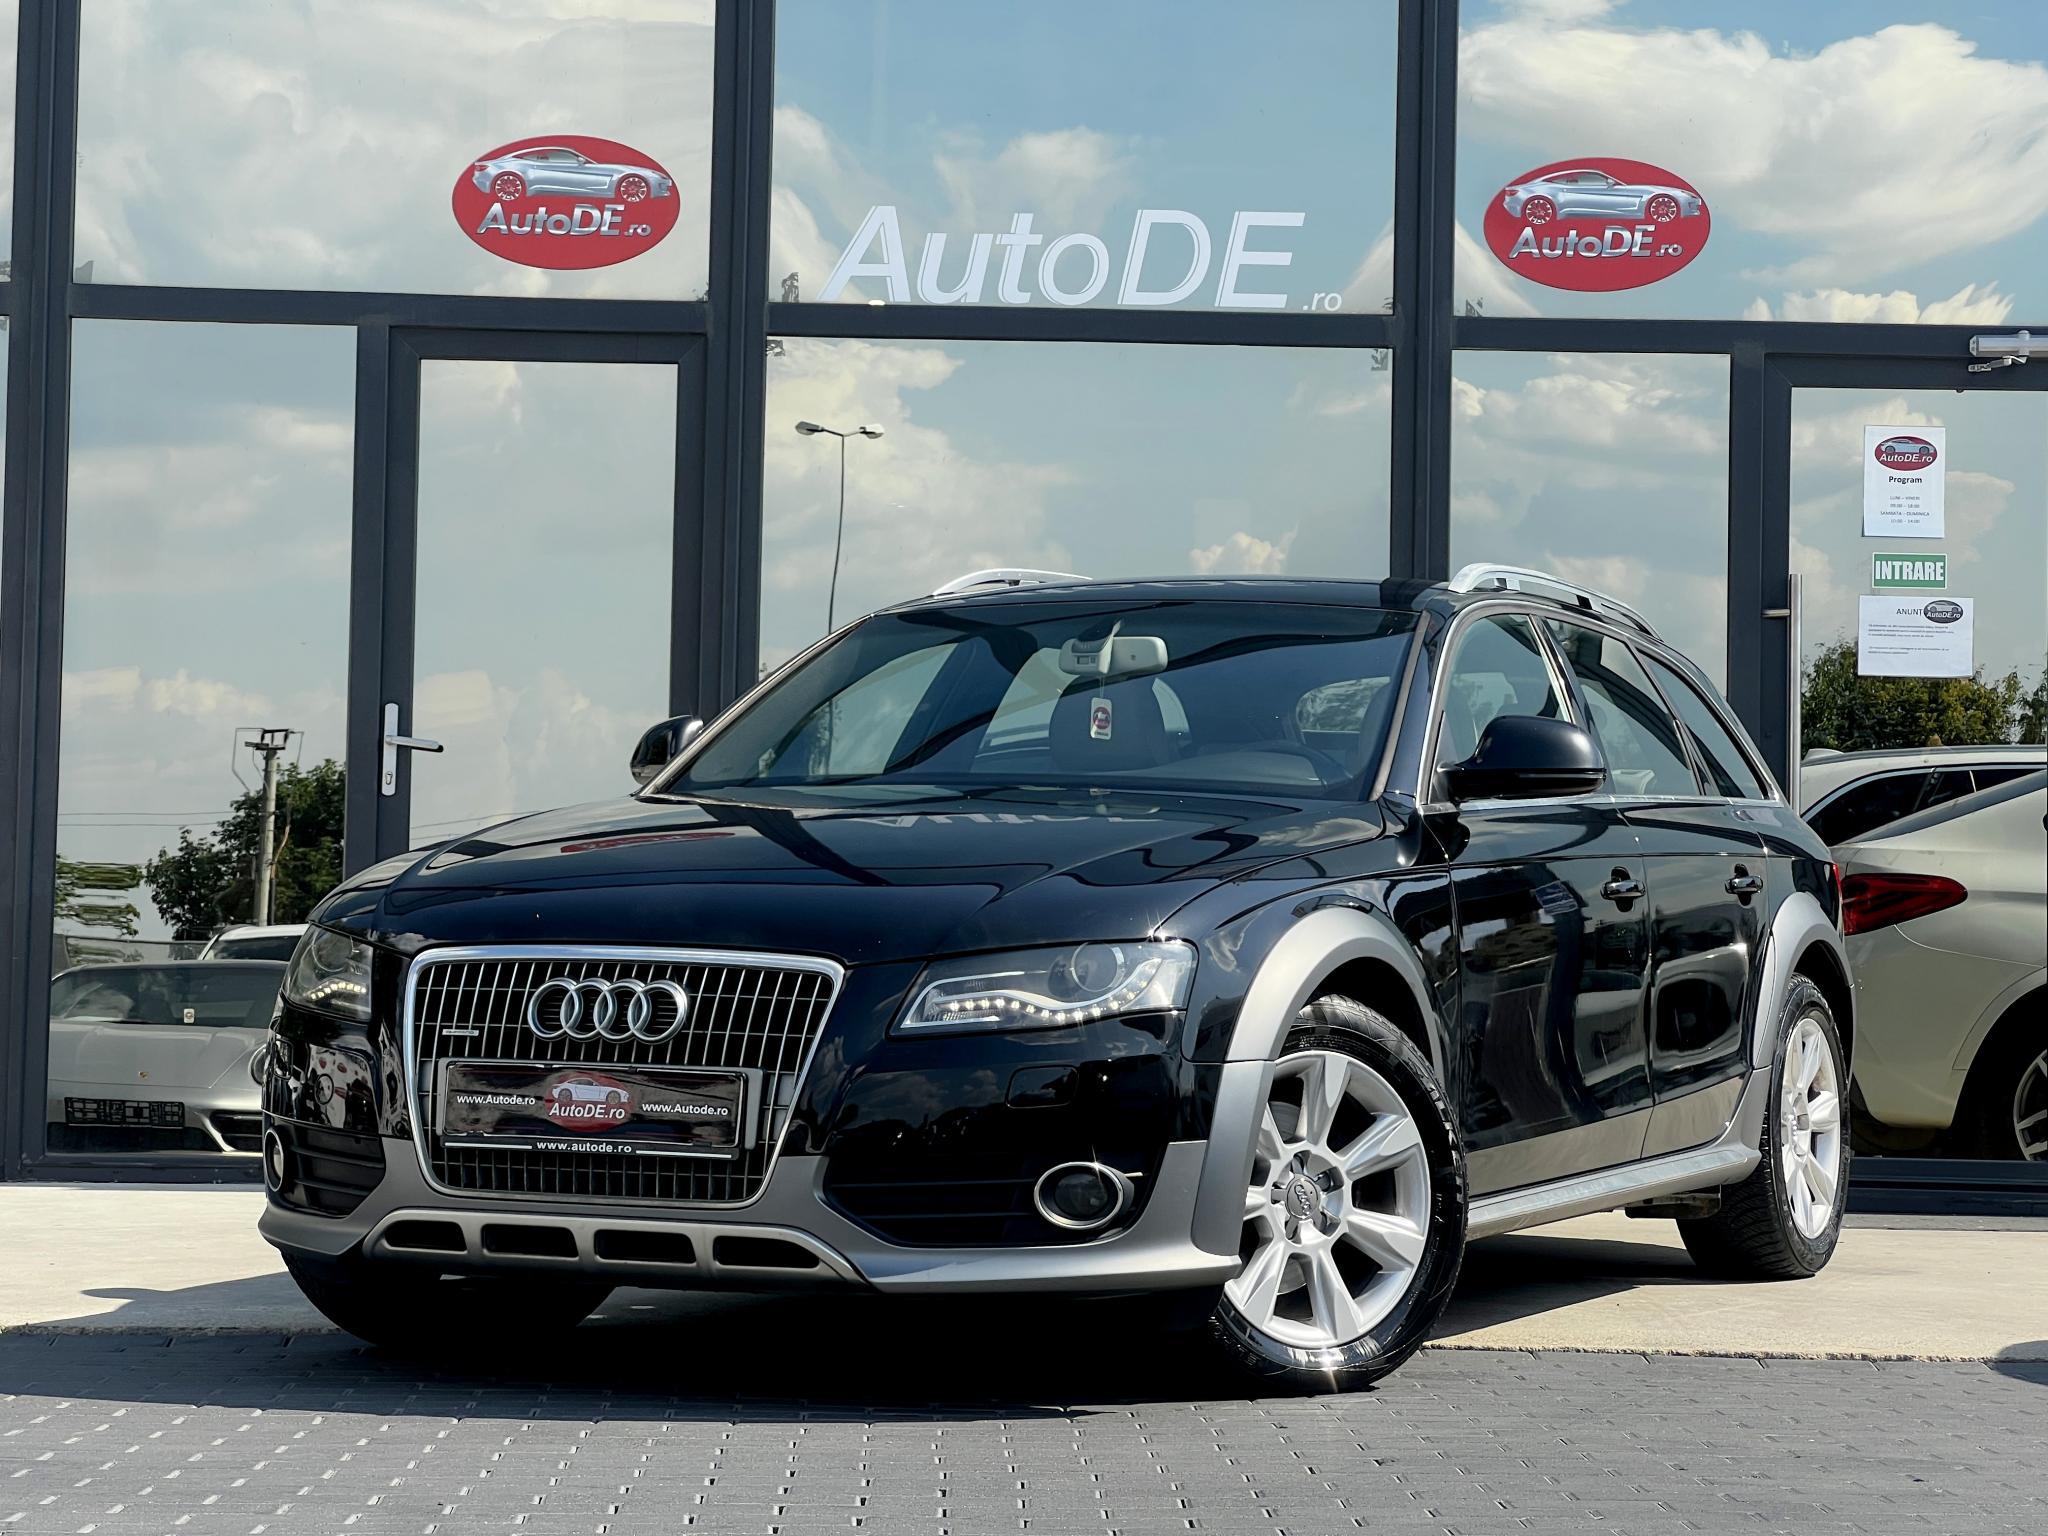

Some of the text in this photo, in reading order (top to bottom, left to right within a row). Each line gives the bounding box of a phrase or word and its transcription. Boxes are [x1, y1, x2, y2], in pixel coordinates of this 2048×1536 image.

[1879, 453, 1933, 463] AutoDE.ro
[1888, 475, 1923, 485] Program
[1875, 560, 1945, 581] INTRARE
[456, 1093, 536, 1106] www.Autode.ro
[549, 1102, 626, 1120] AutoDE.ro
[641, 1102, 729, 1116] www.Autode.ro
[536, 1140, 633, 1154] www.autode.ro
